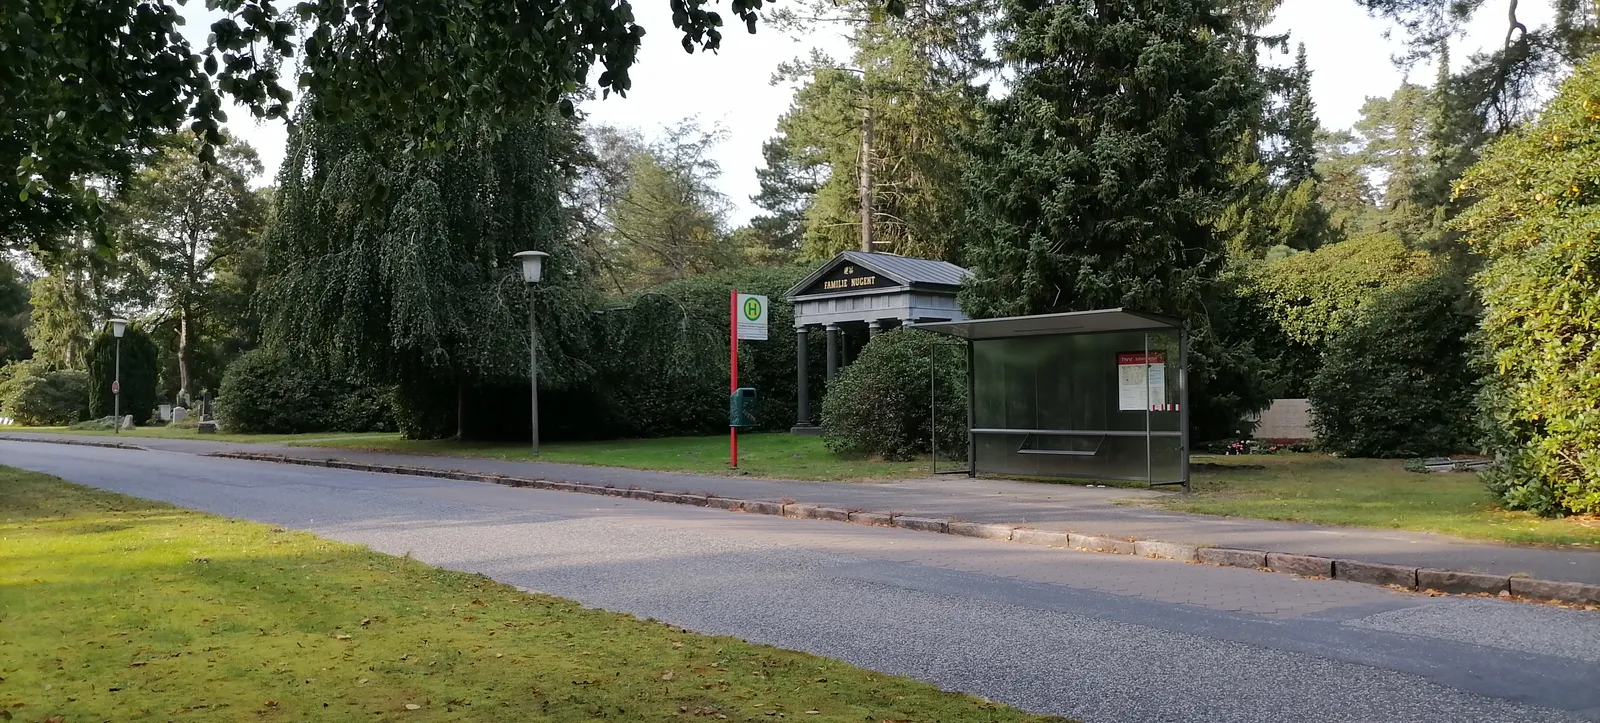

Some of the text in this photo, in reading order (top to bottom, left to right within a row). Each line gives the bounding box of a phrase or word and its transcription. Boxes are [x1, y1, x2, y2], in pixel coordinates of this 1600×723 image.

[824, 276, 876, 290] FAMILIE NUGENT
[748, 302, 756, 316] H
